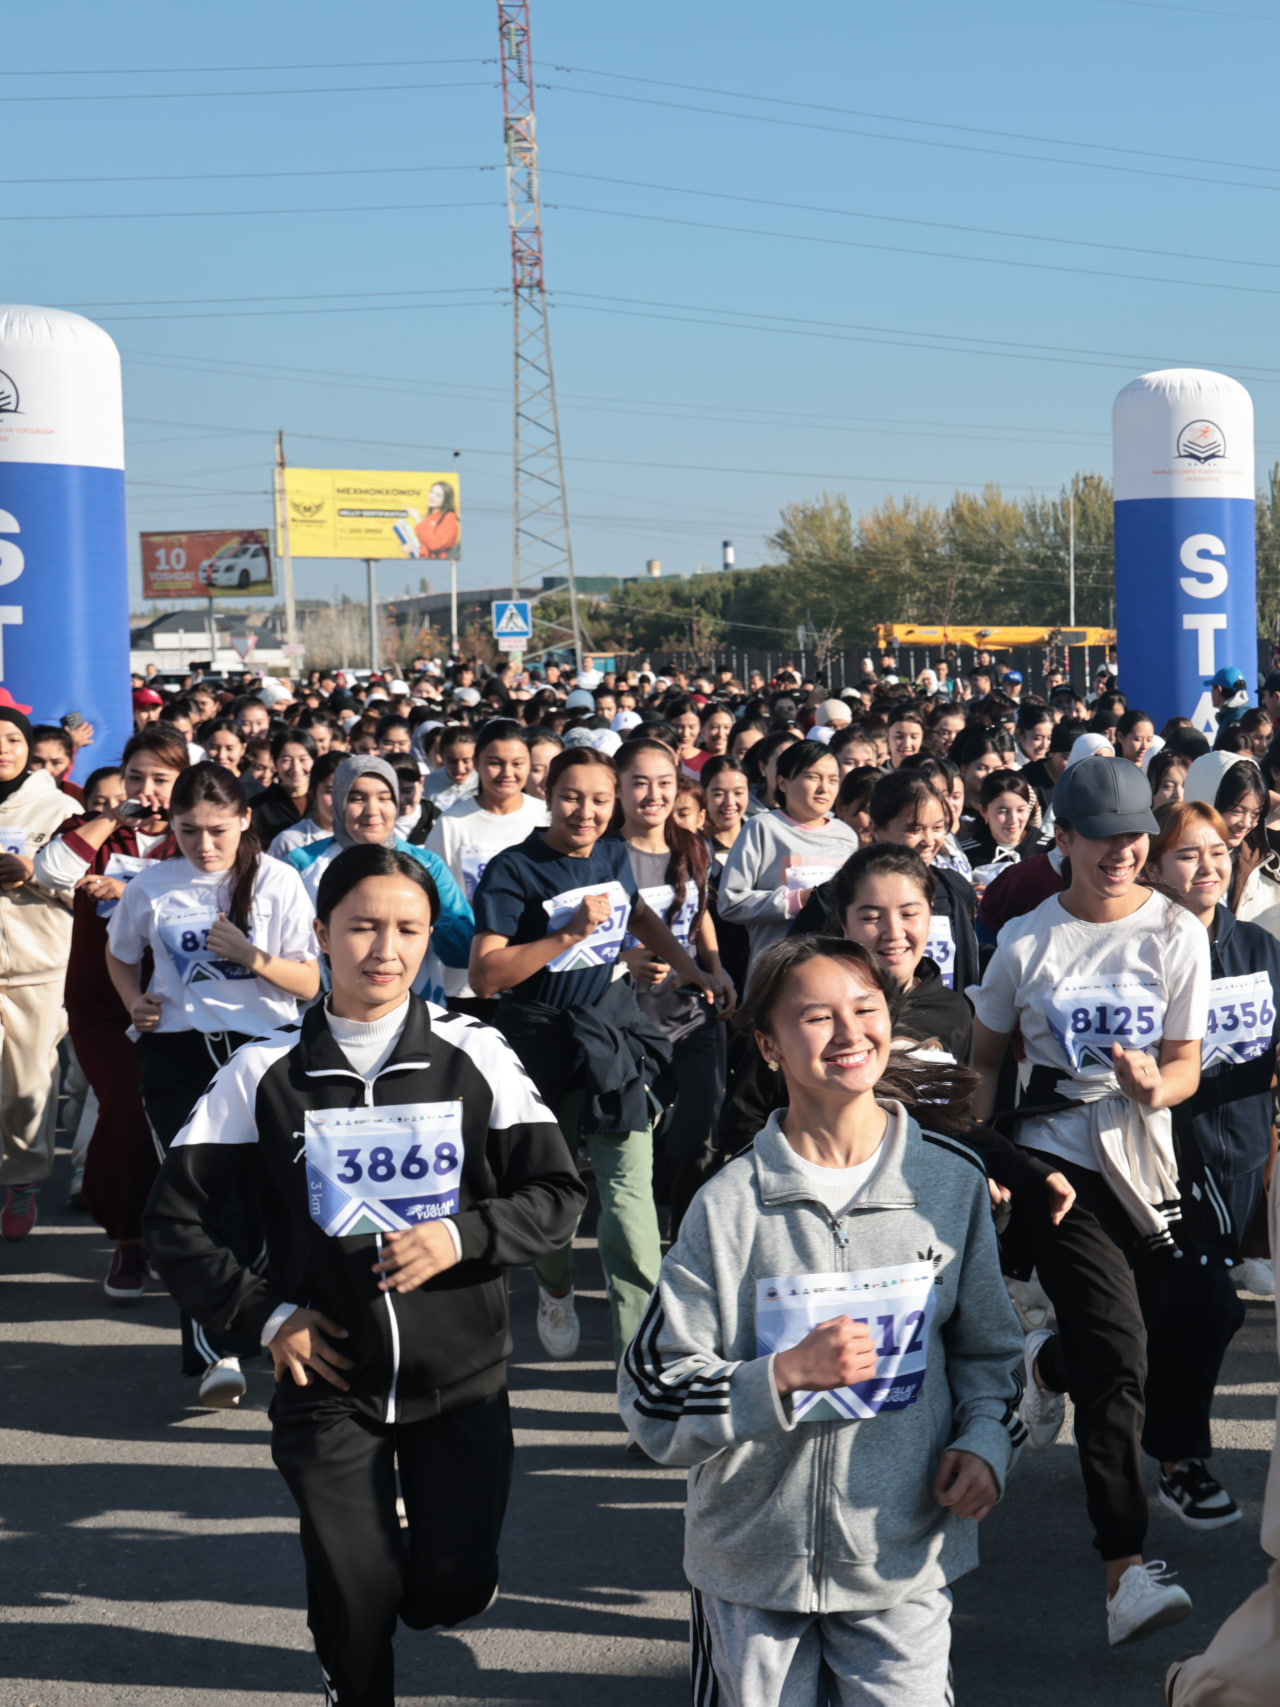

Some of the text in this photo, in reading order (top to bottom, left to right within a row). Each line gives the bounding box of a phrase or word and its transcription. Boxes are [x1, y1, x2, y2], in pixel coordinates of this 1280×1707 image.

[155, 547, 187, 571] 10
[1071, 1006, 1155, 1036] 8125
[1207, 999, 1273, 1034] 4356
[336, 1142, 459, 1184] 3868
[311, 1181, 323, 1216] 3 km
